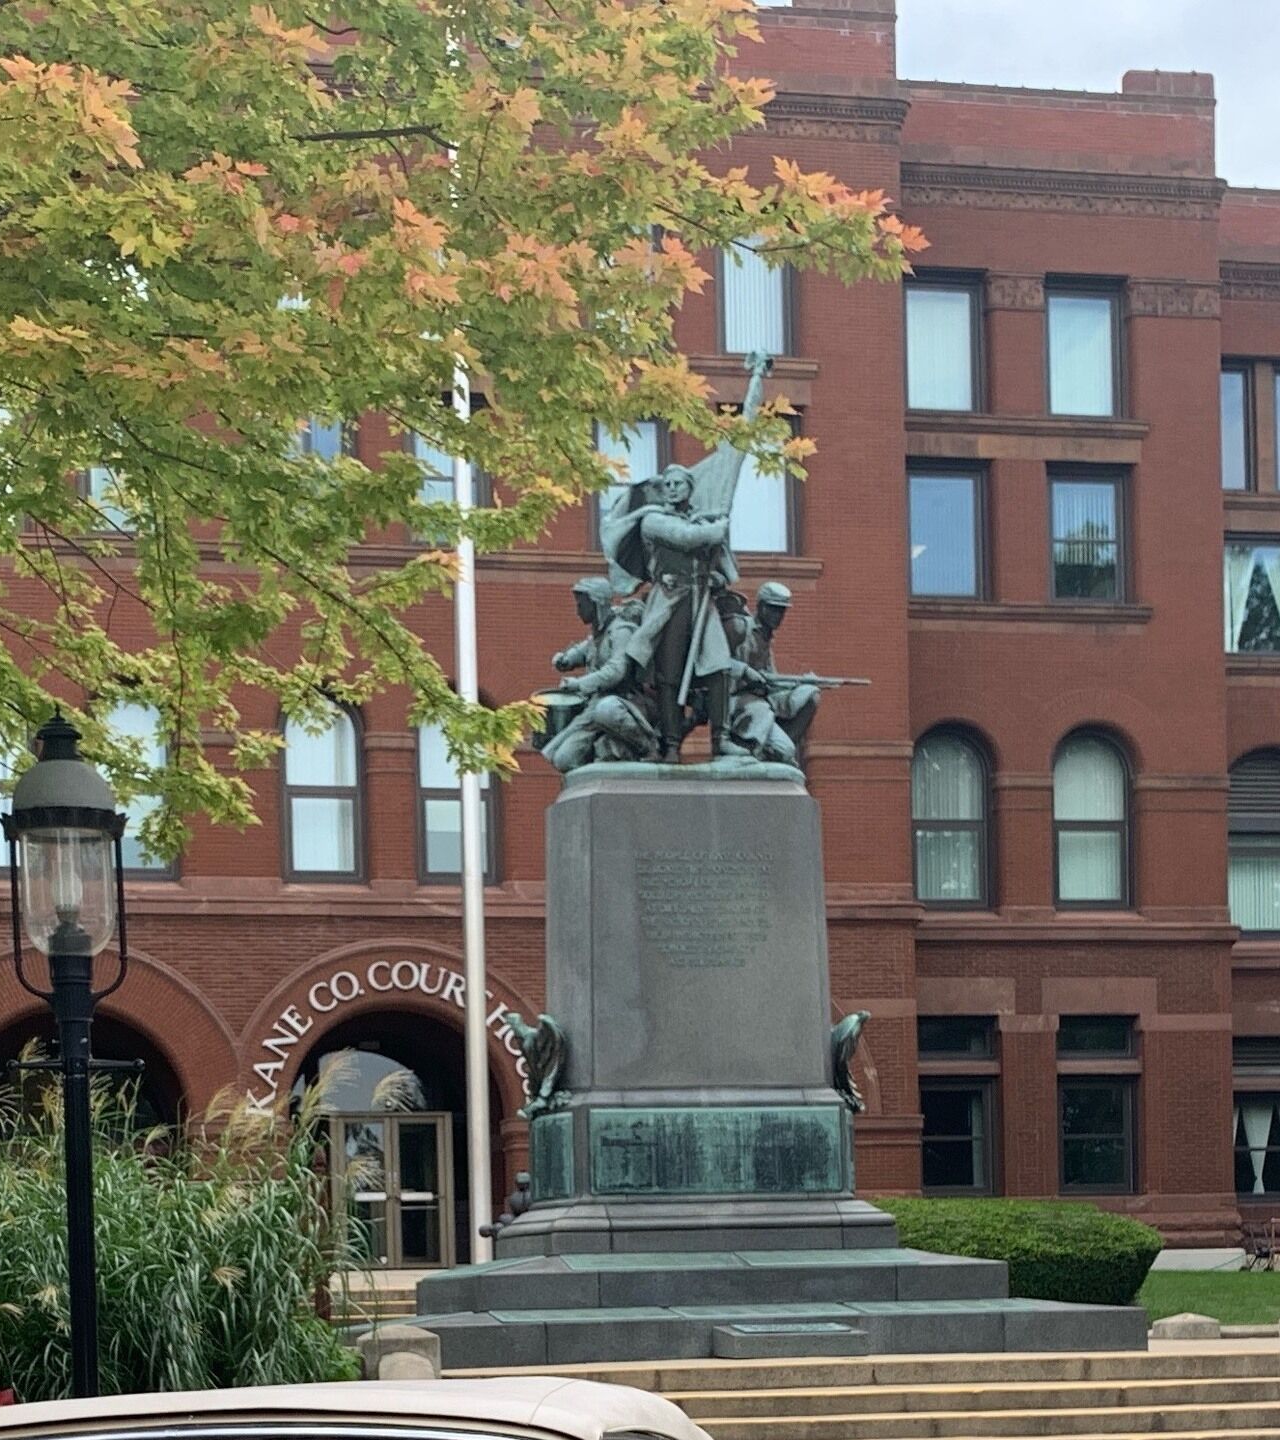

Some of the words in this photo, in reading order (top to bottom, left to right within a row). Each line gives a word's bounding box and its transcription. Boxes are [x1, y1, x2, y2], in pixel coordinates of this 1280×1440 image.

[246, 1003, 314, 1117] KANE
[308, 971, 365, 1013] CO.
[367, 960, 493, 1008] COUR
